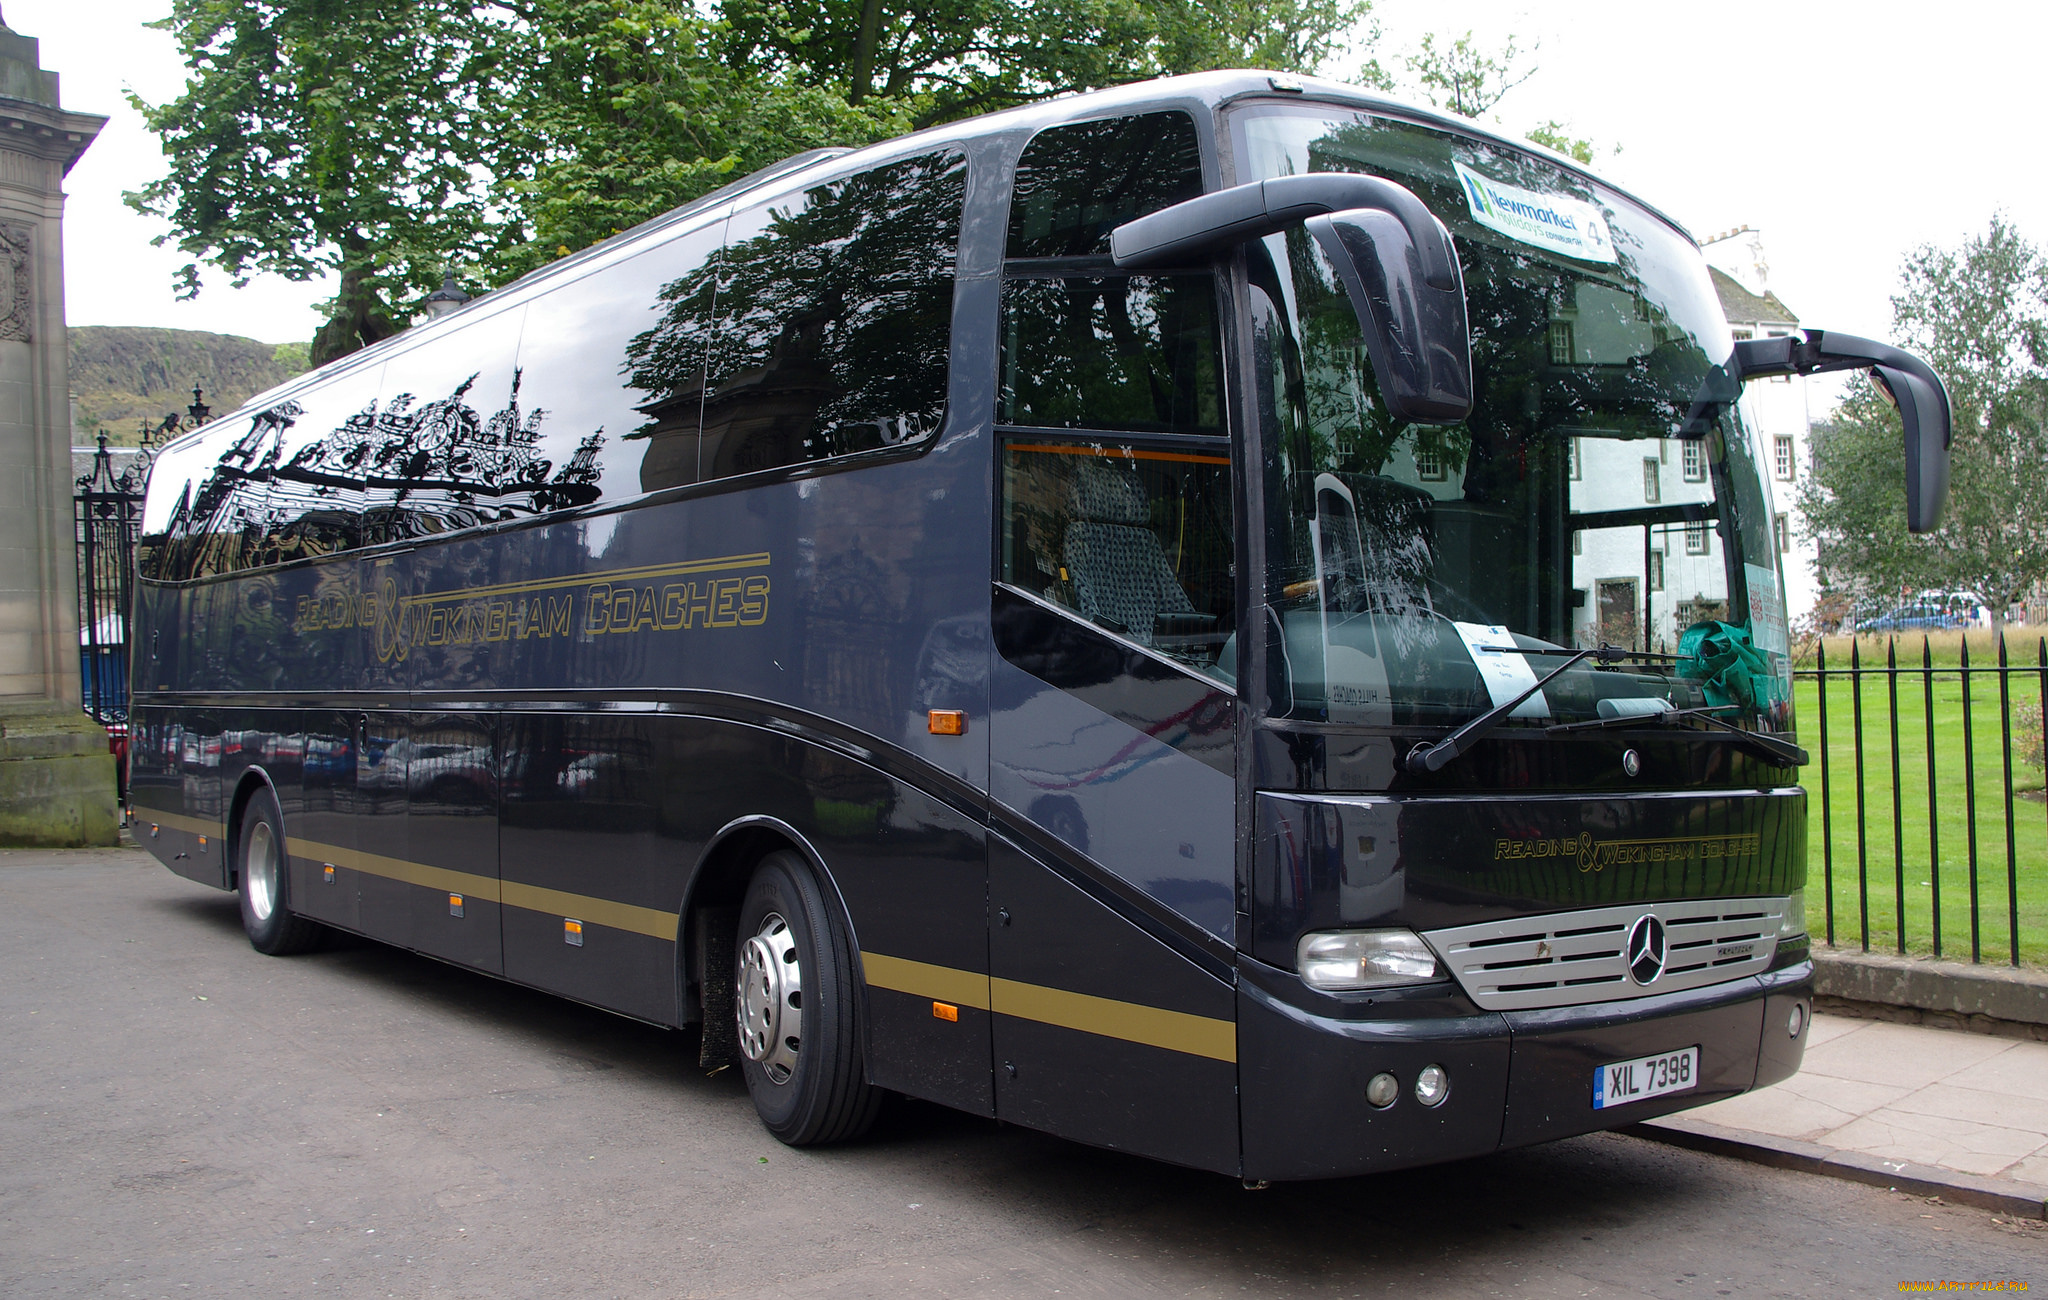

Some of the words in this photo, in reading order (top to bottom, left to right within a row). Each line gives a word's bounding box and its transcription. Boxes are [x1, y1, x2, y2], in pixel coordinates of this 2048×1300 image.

[1487, 188, 1577, 230] Newmarket
[1496, 211, 1545, 237] Holidays
[1588, 221, 1602, 245] 4
[296, 592, 377, 633] READING
[374, 576, 408, 664] &
[408, 594, 573, 648] WOKINGHAM
[584, 574, 771, 635] COACHES
[1765, 613, 1784, 628] TATTOO
[1495, 839, 1577, 860] READING
[1576, 831, 1603, 873] &
[1603, 842, 1694, 865] WOKINGHAM
[1701, 839, 1759, 859] COACHES
[1611, 1065, 1640, 1098] XIL
[1646, 1053, 1690, 1091] 7398
